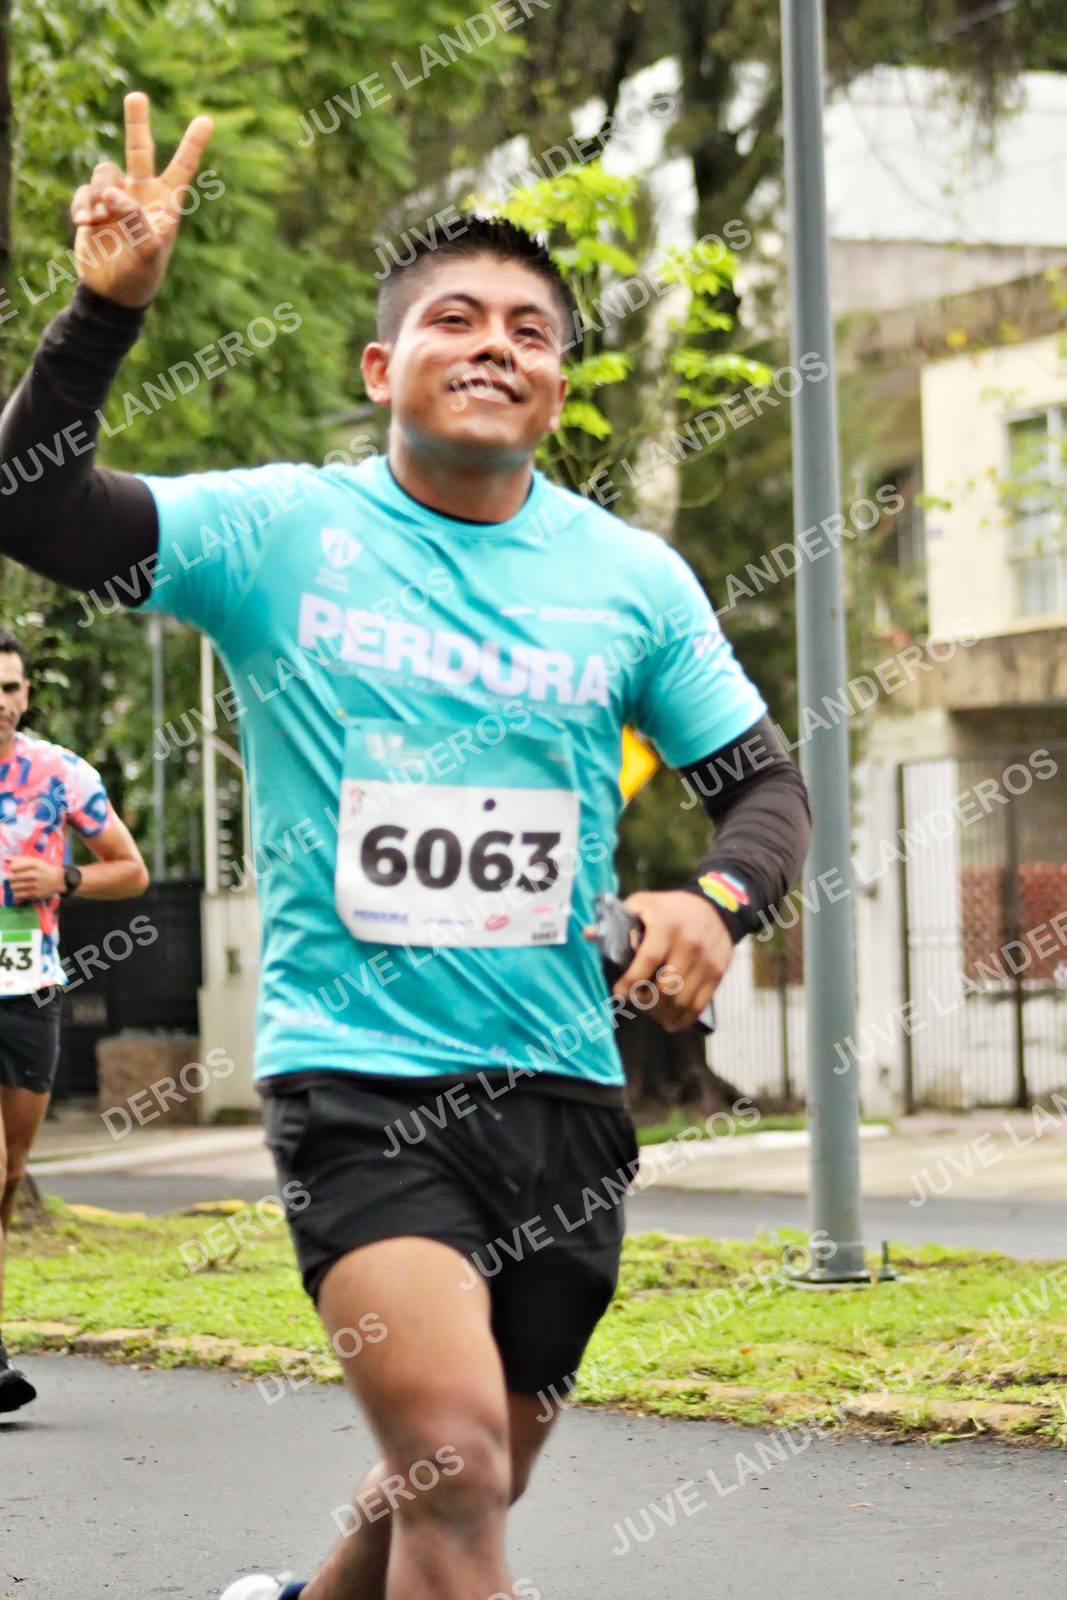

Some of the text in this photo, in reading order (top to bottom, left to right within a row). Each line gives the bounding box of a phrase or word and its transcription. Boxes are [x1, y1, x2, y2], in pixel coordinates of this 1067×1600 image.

[297, 591, 611, 708] PERDURA
[360, 824, 561, 894] 6063
[0, 947, 33, 971] 43
